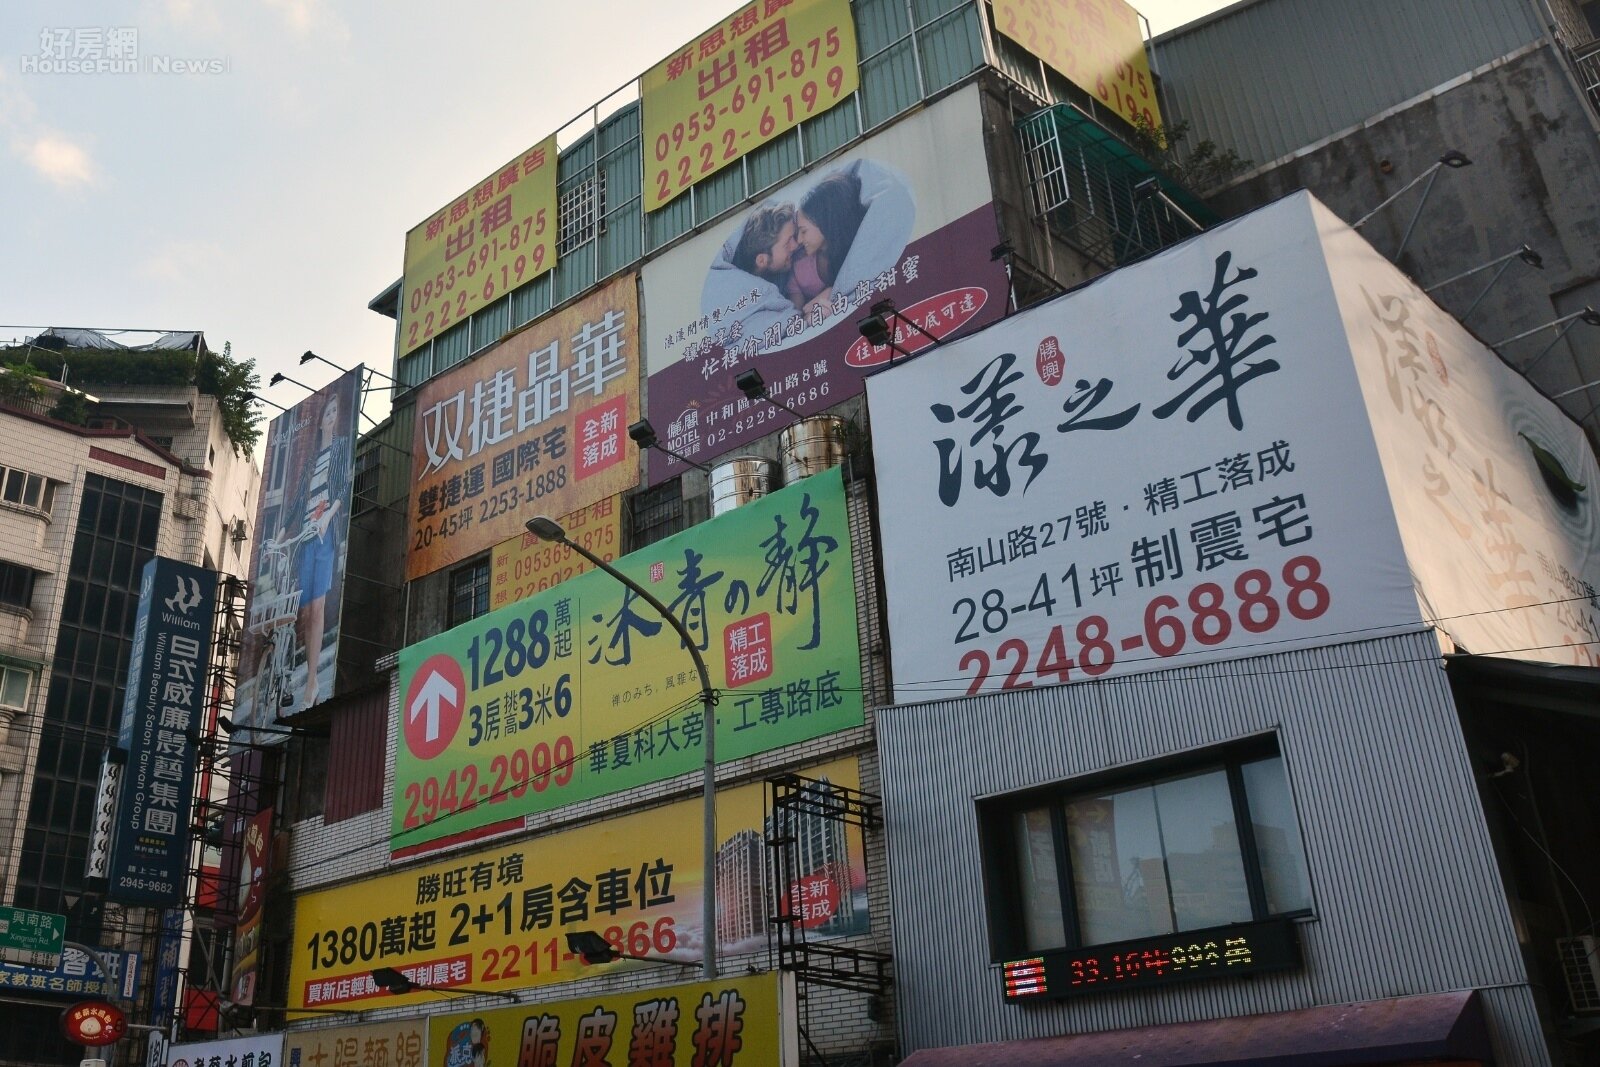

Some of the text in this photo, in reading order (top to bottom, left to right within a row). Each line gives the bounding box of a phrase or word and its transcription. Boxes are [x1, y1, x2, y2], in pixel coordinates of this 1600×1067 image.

[655, 26, 841, 163] 0953-691-875
[697, 17, 790, 101] 出租
[656, 65, 844, 201] 2222-6199
[424, 146, 546, 242] 新思想廣告
[444, 193, 513, 263] 出租
[407, 243, 546, 348] 2222-6199
[410, 207, 546, 315] 0953-691-875
[418, 309, 627, 481] 双捷晶華
[706, 359, 828, 427] 中和區山路8號
[707, 381, 830, 447] 02-8228-6686
[929, 250, 1282, 508] 漾之華
[581, 434, 618, 469] 落成
[582, 406, 619, 443] 全新
[667, 428, 701, 453] MOTEL
[415, 464, 567, 551] 20-45坪 2253-1888
[416, 424, 567, 523] 雙捷運 國際宅
[945, 438, 1296, 583] 南山路27號 精工落成
[951, 493, 1314, 645] 28-41坪 制震宅
[161, 611, 201, 632] William
[728, 620, 767, 653] 精工
[957, 554, 1332, 697] 2248-6888
[729, 645, 769, 683] 落成
[131, 631, 168, 831] William Beauty Salon Taiwan Group
[144, 634, 201, 837] 日式威廉髮藝集團
[589, 669, 844, 775] 華夏科大旁 工專路底
[402, 735, 575, 829] 2942-2999
[12, 911, 53, 930] 興南路
[119, 876, 173, 894] 2945-9682
[306, 909, 437, 972] 1380萬起
[447, 857, 676, 948] 2+1房含車位
[415, 851, 525, 906] 勝旺有境
[790, 878, 831, 904] 全新
[791, 899, 833, 923] 落成
[307, 960, 467, 1003] 買新店輕軌制震宅
[480, 915, 678, 984] 2211-866
[518, 988, 746, 1067] 脆皮雞排
